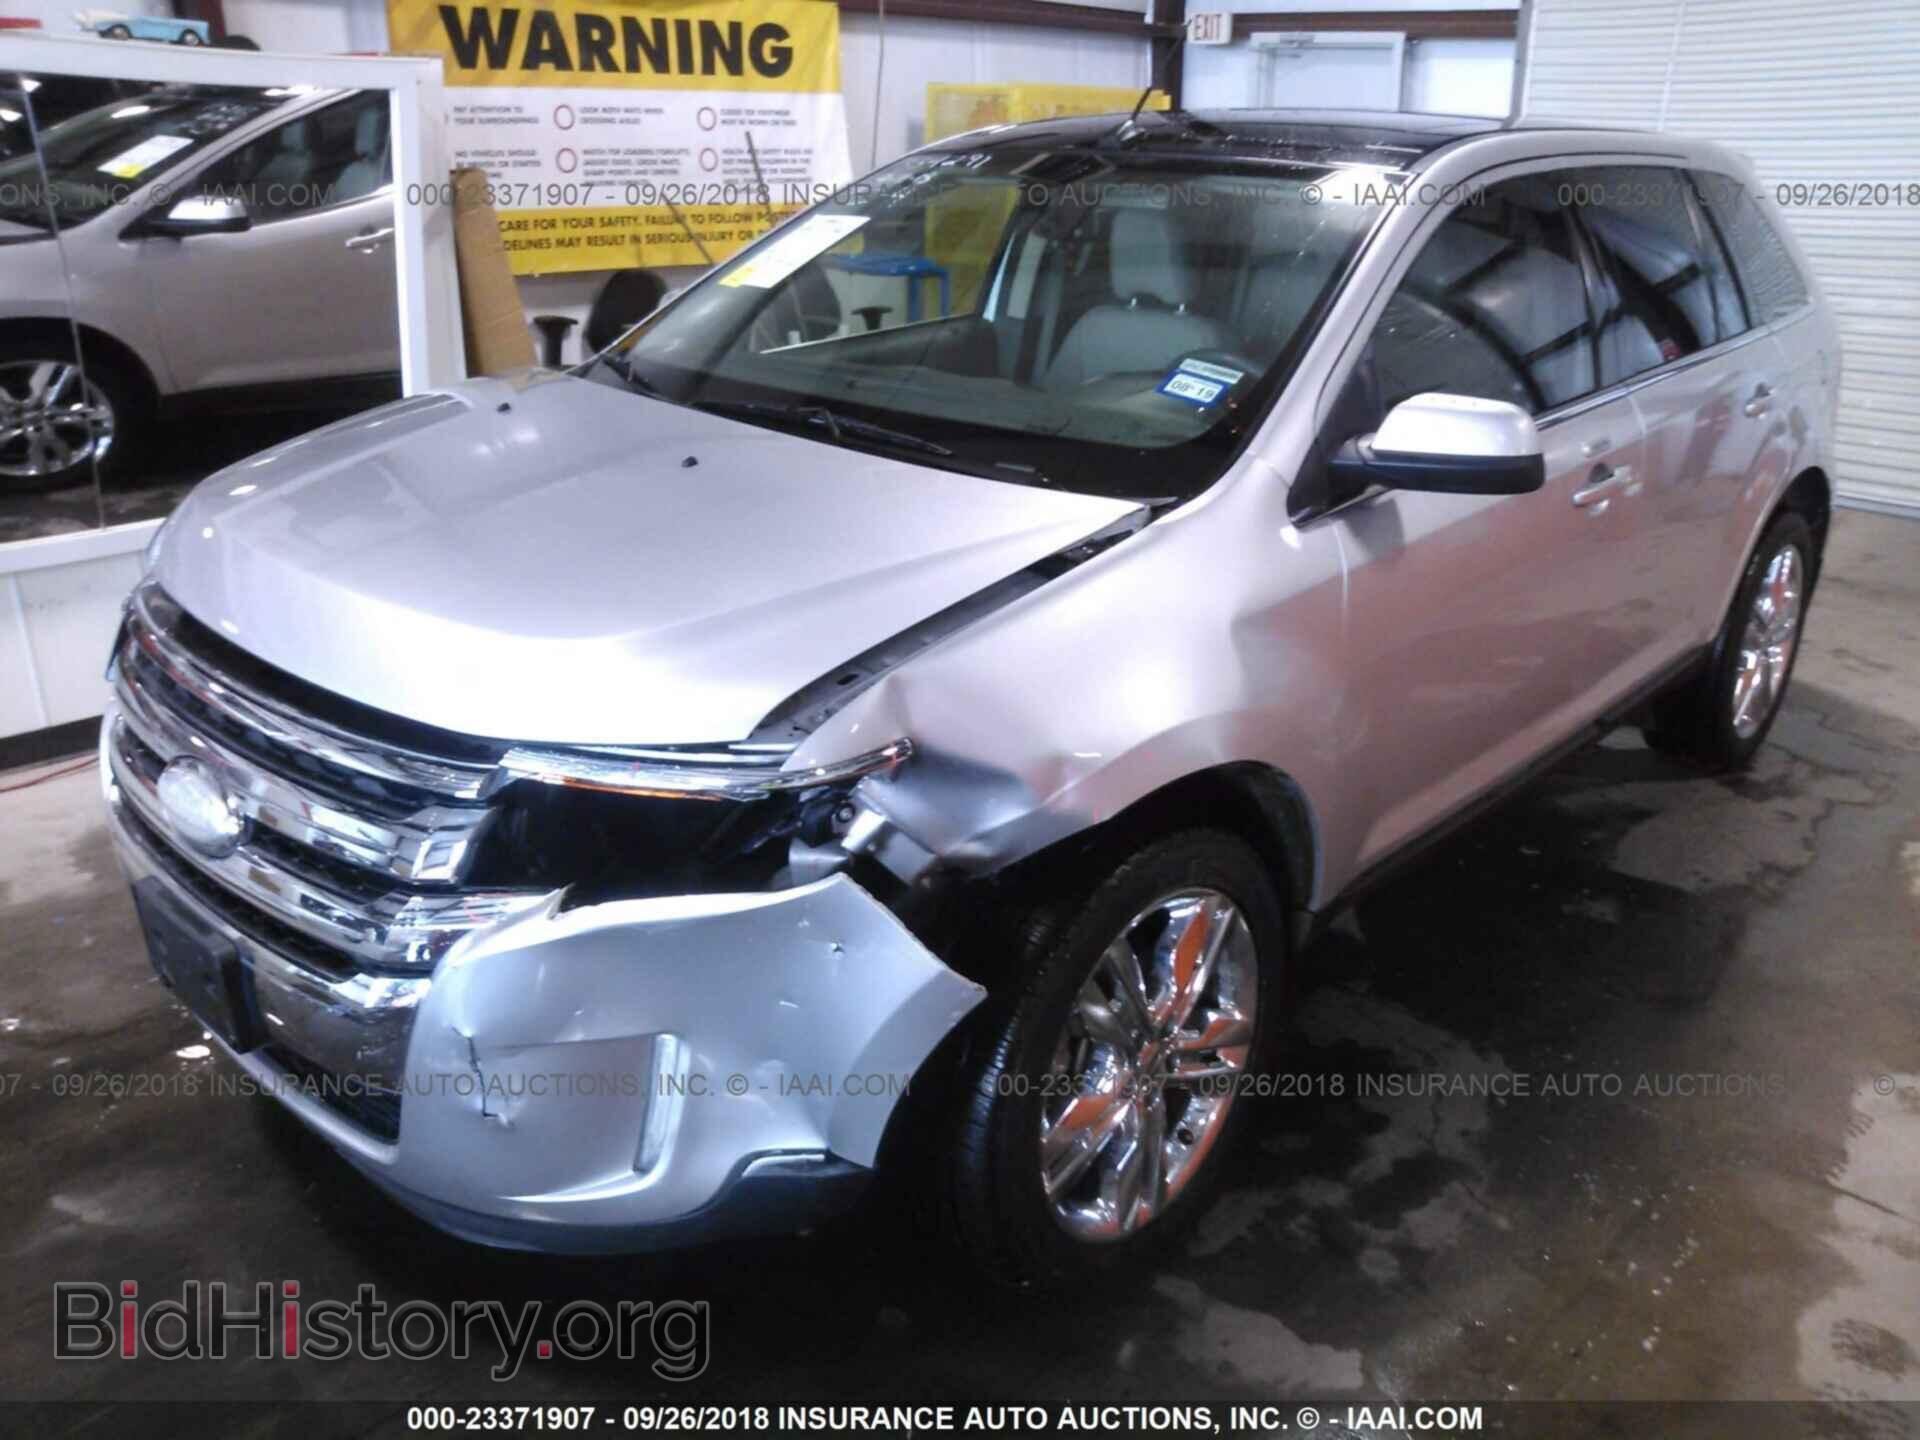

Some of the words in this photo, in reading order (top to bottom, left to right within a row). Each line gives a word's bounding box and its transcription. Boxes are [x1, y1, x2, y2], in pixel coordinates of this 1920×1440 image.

[1193, 13, 1222, 40] EXIT
[437, 5, 794, 78] WARNING
[533, 219, 557, 231] FOR
[562, 217, 594, 229] YOUR
[690, 213, 705, 225] TO
[708, 212, 752, 224] FOLLOW
[555, 237, 582, 248] MAY
[587, 234, 625, 247] RESULT
